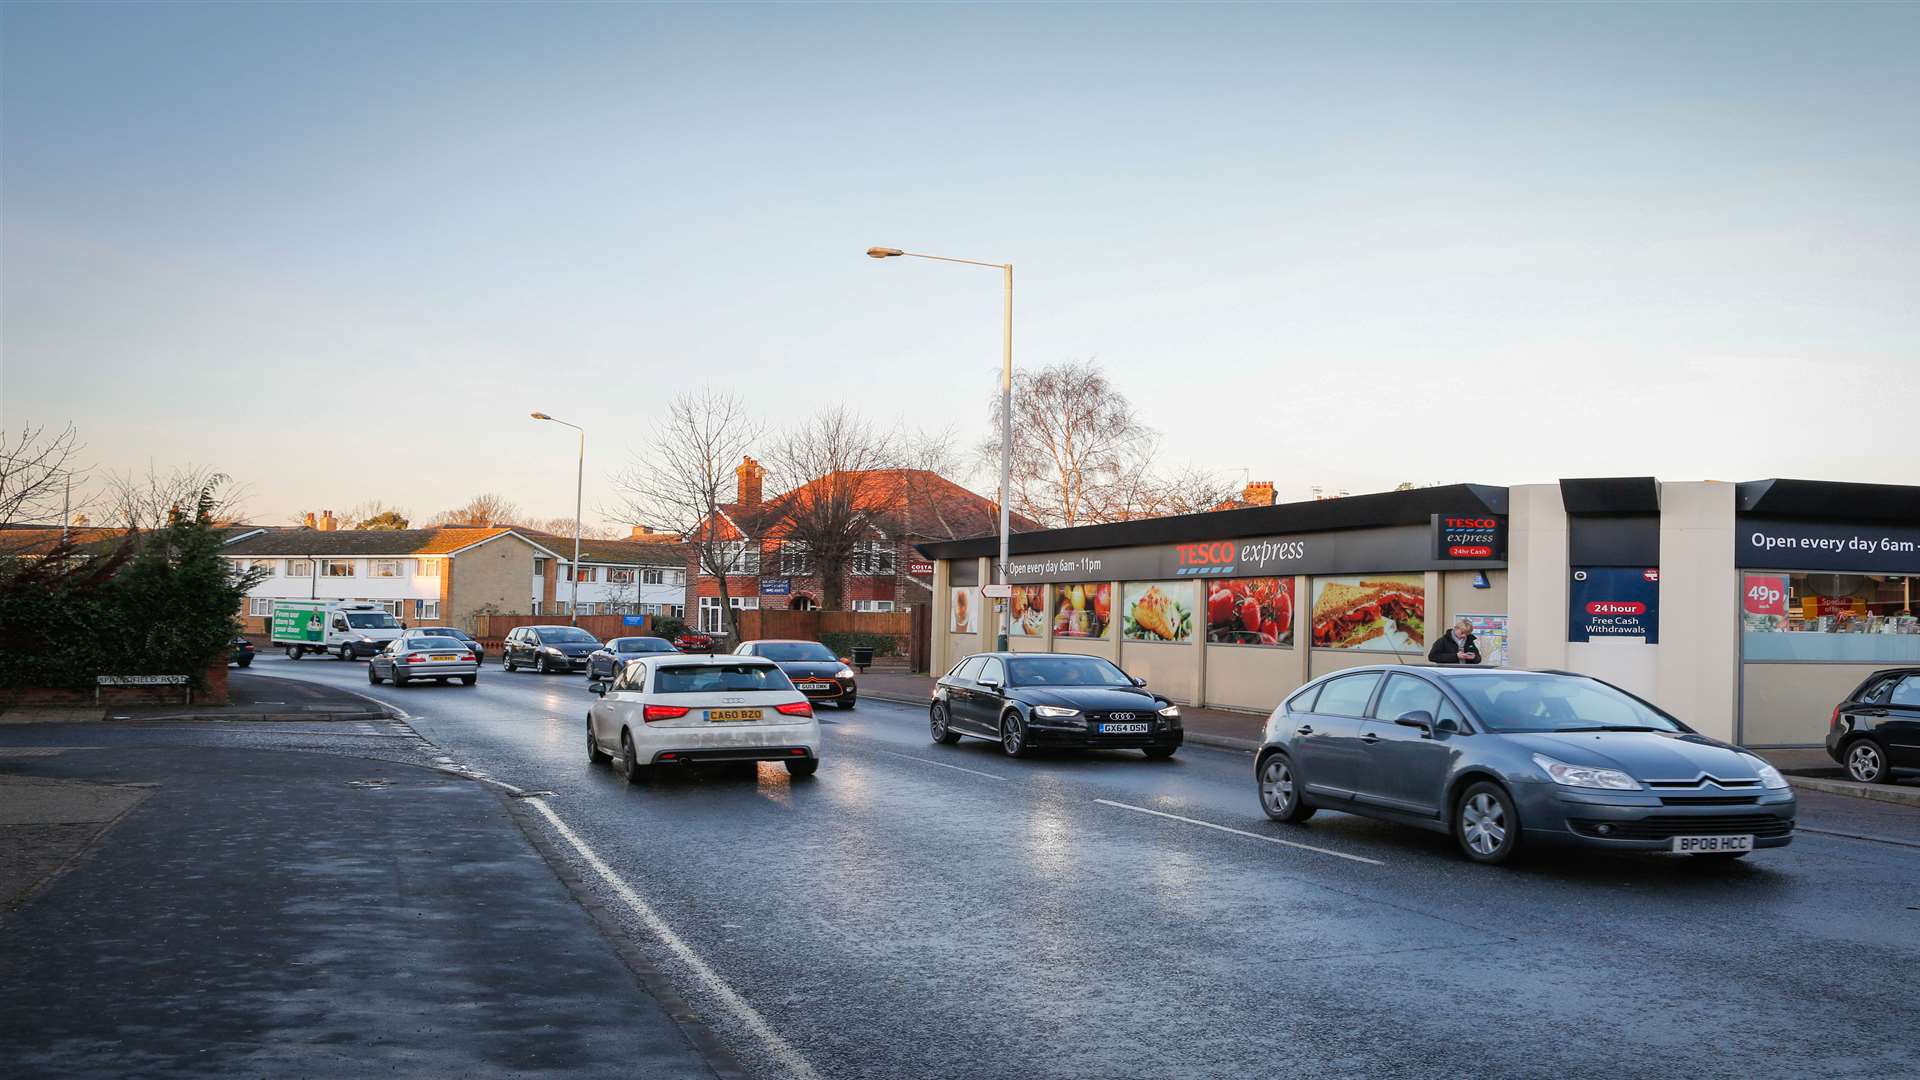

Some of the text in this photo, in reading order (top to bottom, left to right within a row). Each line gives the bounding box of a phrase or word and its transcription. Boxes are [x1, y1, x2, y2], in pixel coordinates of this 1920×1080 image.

[1446, 518, 1496, 528] TESCO
[1447, 534, 1494, 544] express
[1751, 532, 1913, 553] Open every day 6am
[1176, 540, 1304, 568] TESCO express
[1009, 561, 1027, 577] Open
[1027, 562, 1044, 575] every
[1045, 560, 1058, 575] day
[1059, 559, 1075, 572] 6am
[1080, 557, 1102, 573] 11pm
[1748, 585, 1780, 605] 49p
[1594, 604, 1637, 612] 24 hour
[1592, 617, 1639, 625] Free Cash
[1585, 625, 1645, 633] Withdrawals
[98, 676, 157, 684] SPRGFIELD
[711, 710, 762, 720] CA60 BZO
[1104, 724, 1128, 732] GX64
[1681, 837, 1747, 850] BP08 HCC
